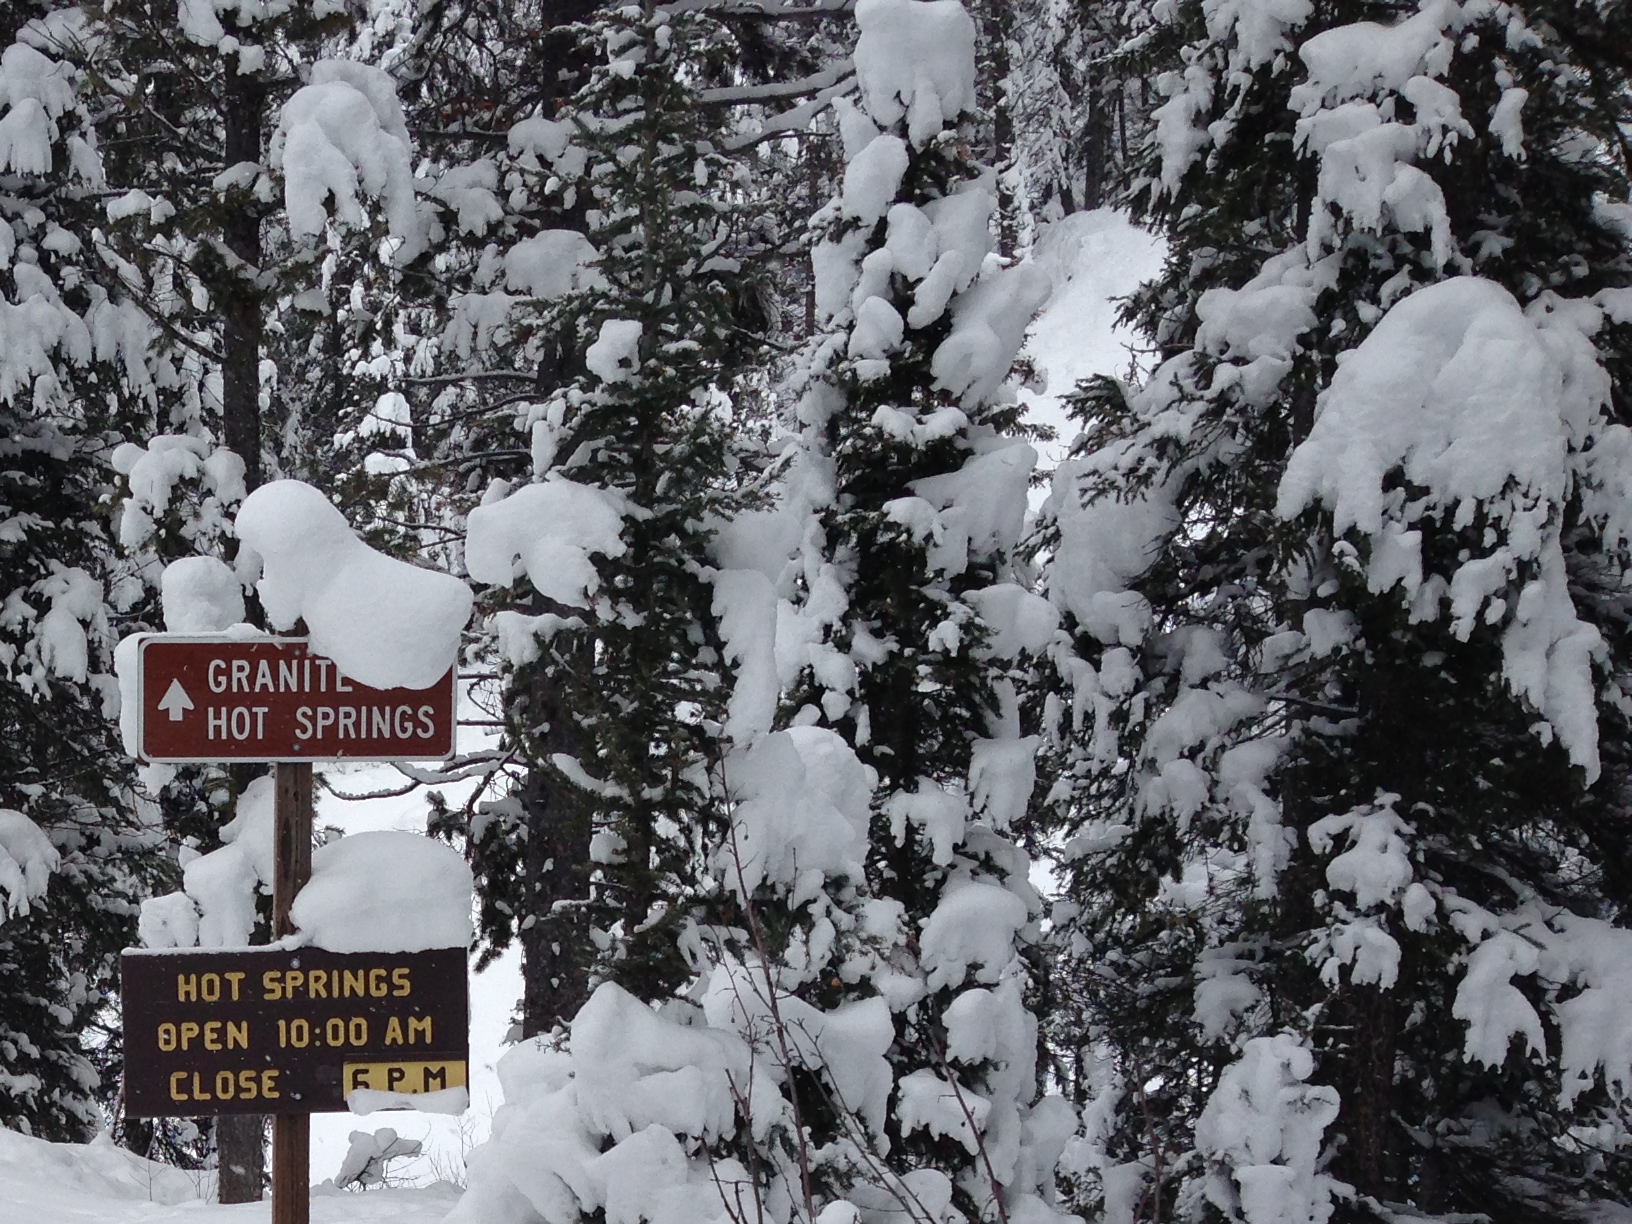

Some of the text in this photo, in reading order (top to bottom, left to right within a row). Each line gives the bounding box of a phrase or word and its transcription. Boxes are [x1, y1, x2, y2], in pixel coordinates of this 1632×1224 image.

[207, 705, 435, 740] HOT SPRINGS
[177, 967, 411, 1002] HOT SPRINGS
[157, 1015, 433, 1051] OPEN 10:00 AM
[170, 1069, 280, 1101] CLOSE
